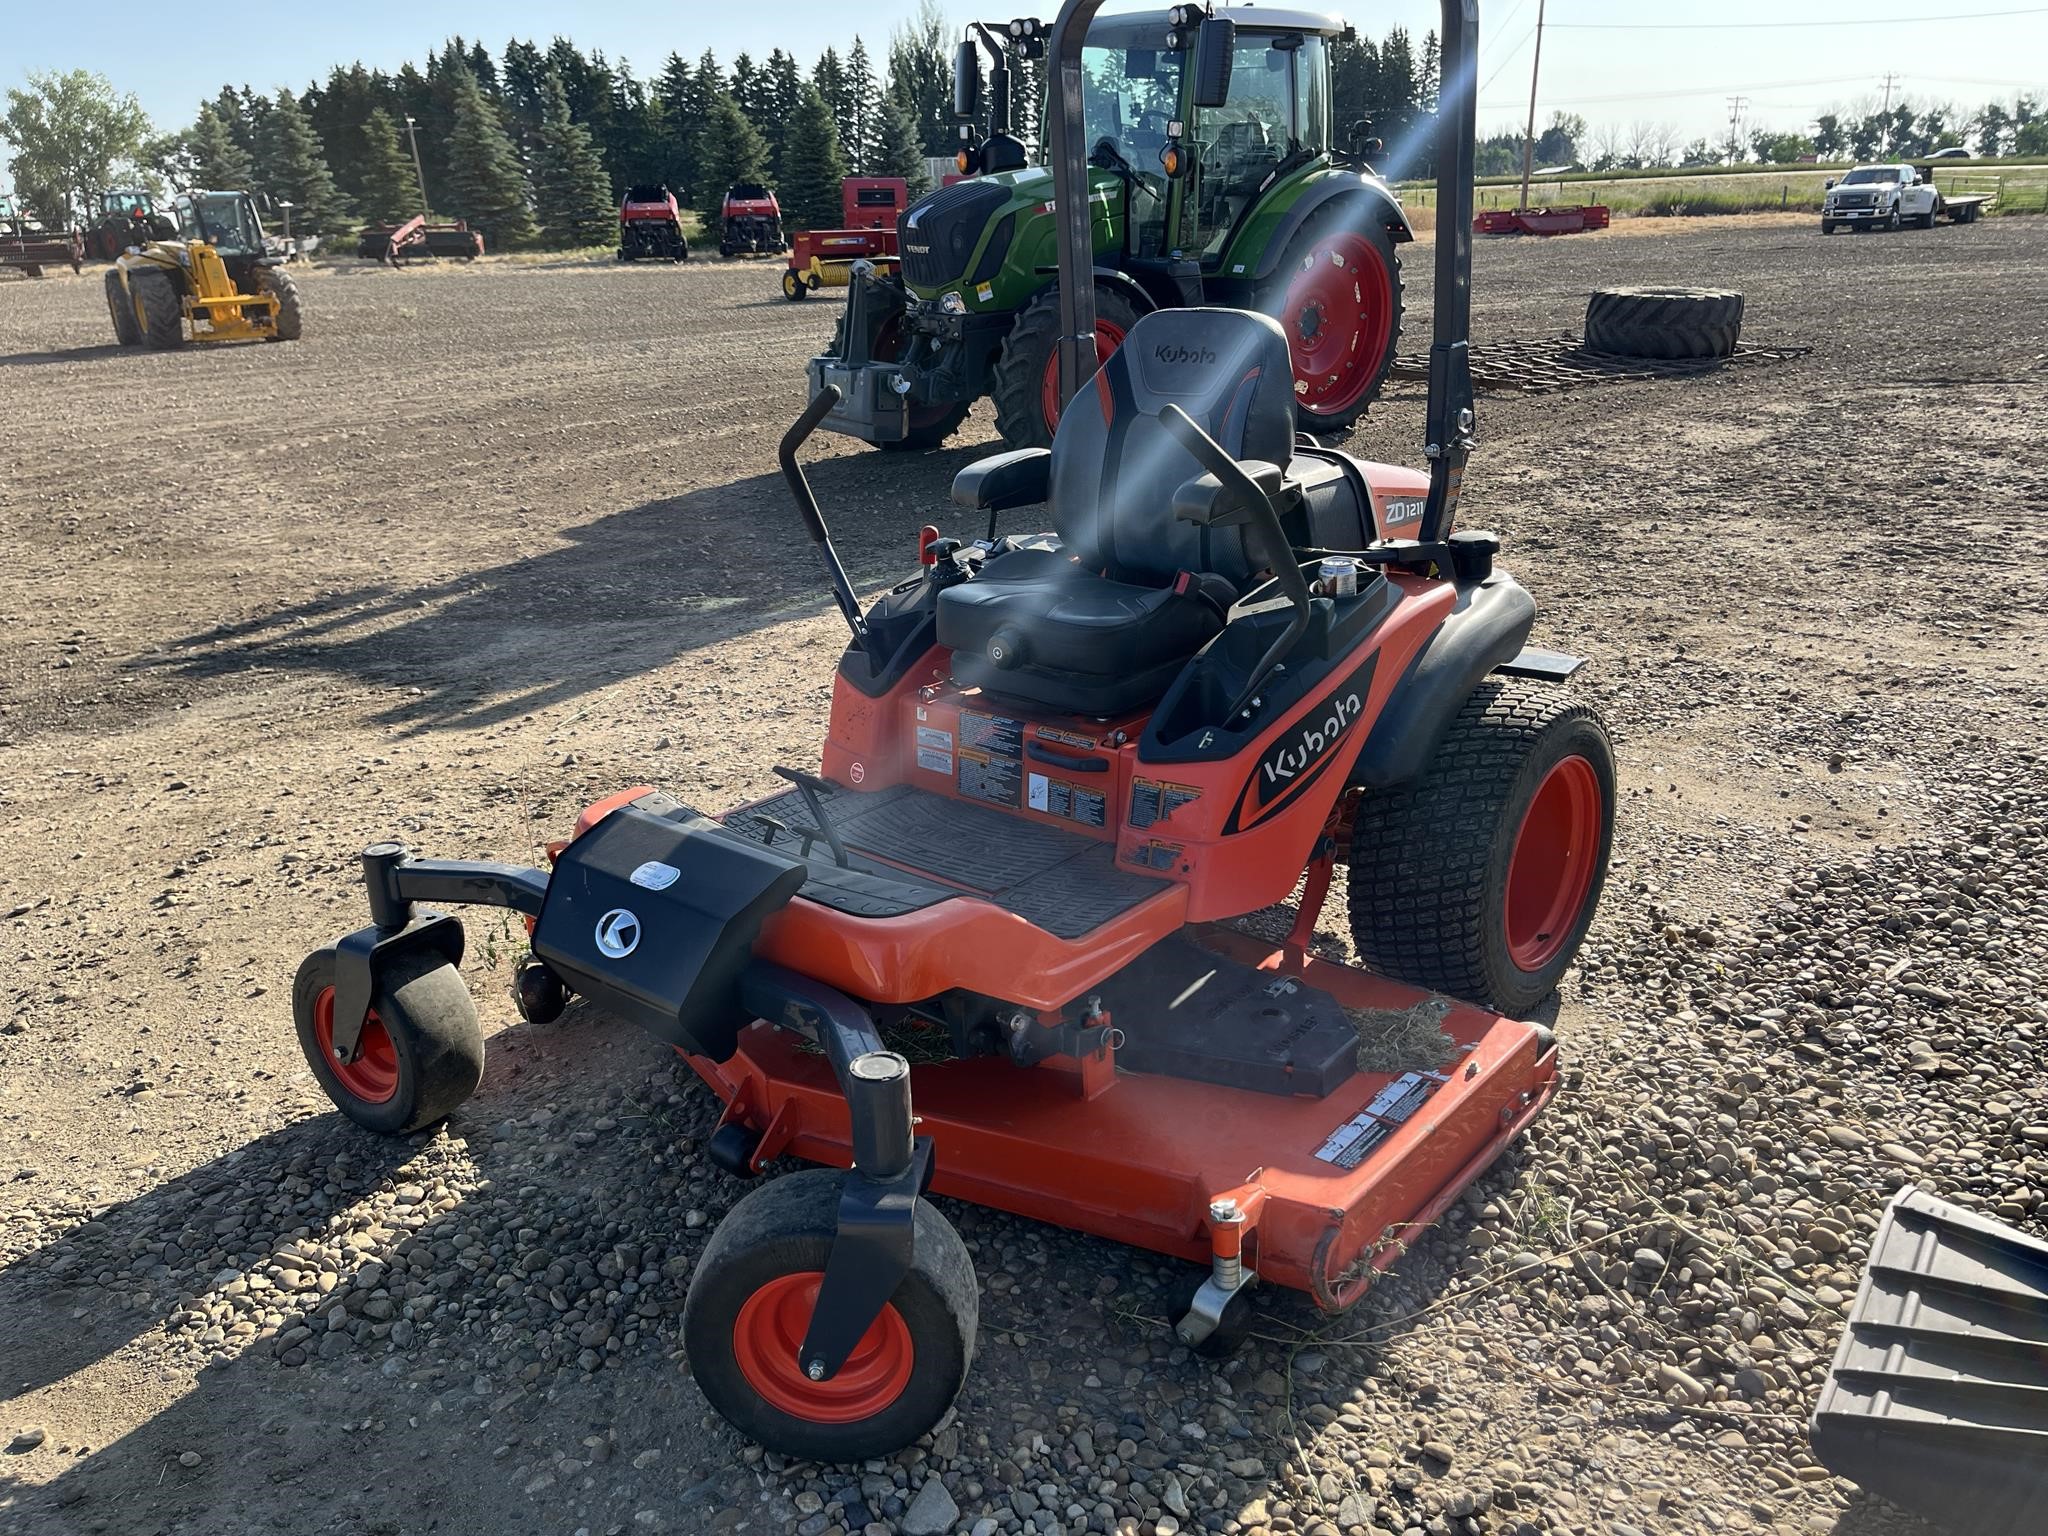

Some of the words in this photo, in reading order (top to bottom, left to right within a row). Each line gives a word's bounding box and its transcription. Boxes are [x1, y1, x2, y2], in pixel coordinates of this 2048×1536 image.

[906, 244, 930, 254] FENDT
[1154, 345, 1217, 364] Kubota
[1264, 693, 1361, 783] Kubota
